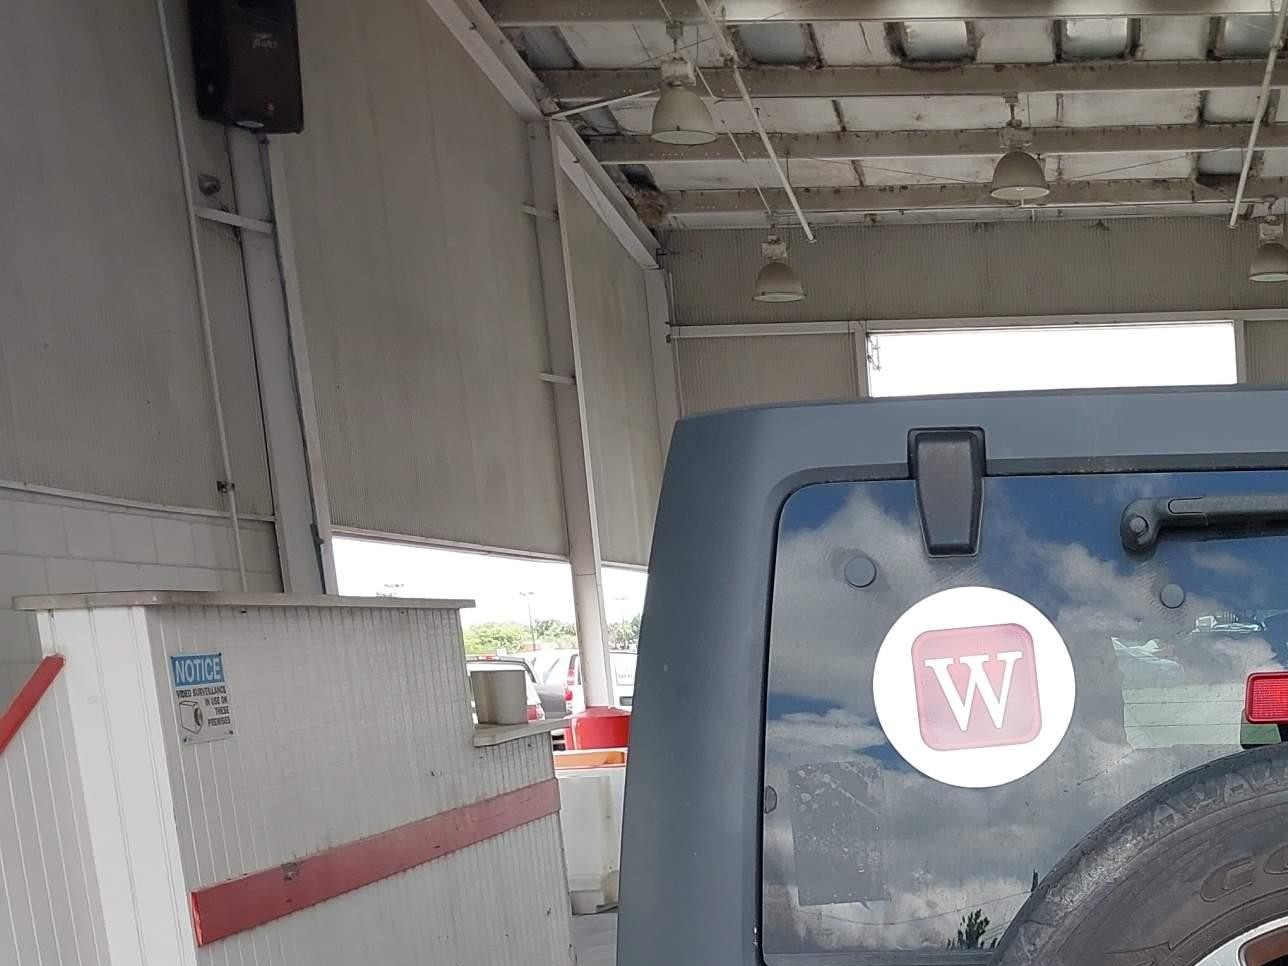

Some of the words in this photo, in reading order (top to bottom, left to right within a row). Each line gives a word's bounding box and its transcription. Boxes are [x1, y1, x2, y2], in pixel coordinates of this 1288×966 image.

[175, 657, 222, 684] NOTICE
[176, 689, 192, 699] VIDEO
[192, 685, 227, 697] SURVEILLANCE
[925, 650, 1025, 732] W
[204, 697, 211, 706] IN
[210, 696, 220, 705] USE
[220, 695, 228, 704] ON
[214, 706, 230, 715] THESE
[207, 716, 231, 727] PREMISES
